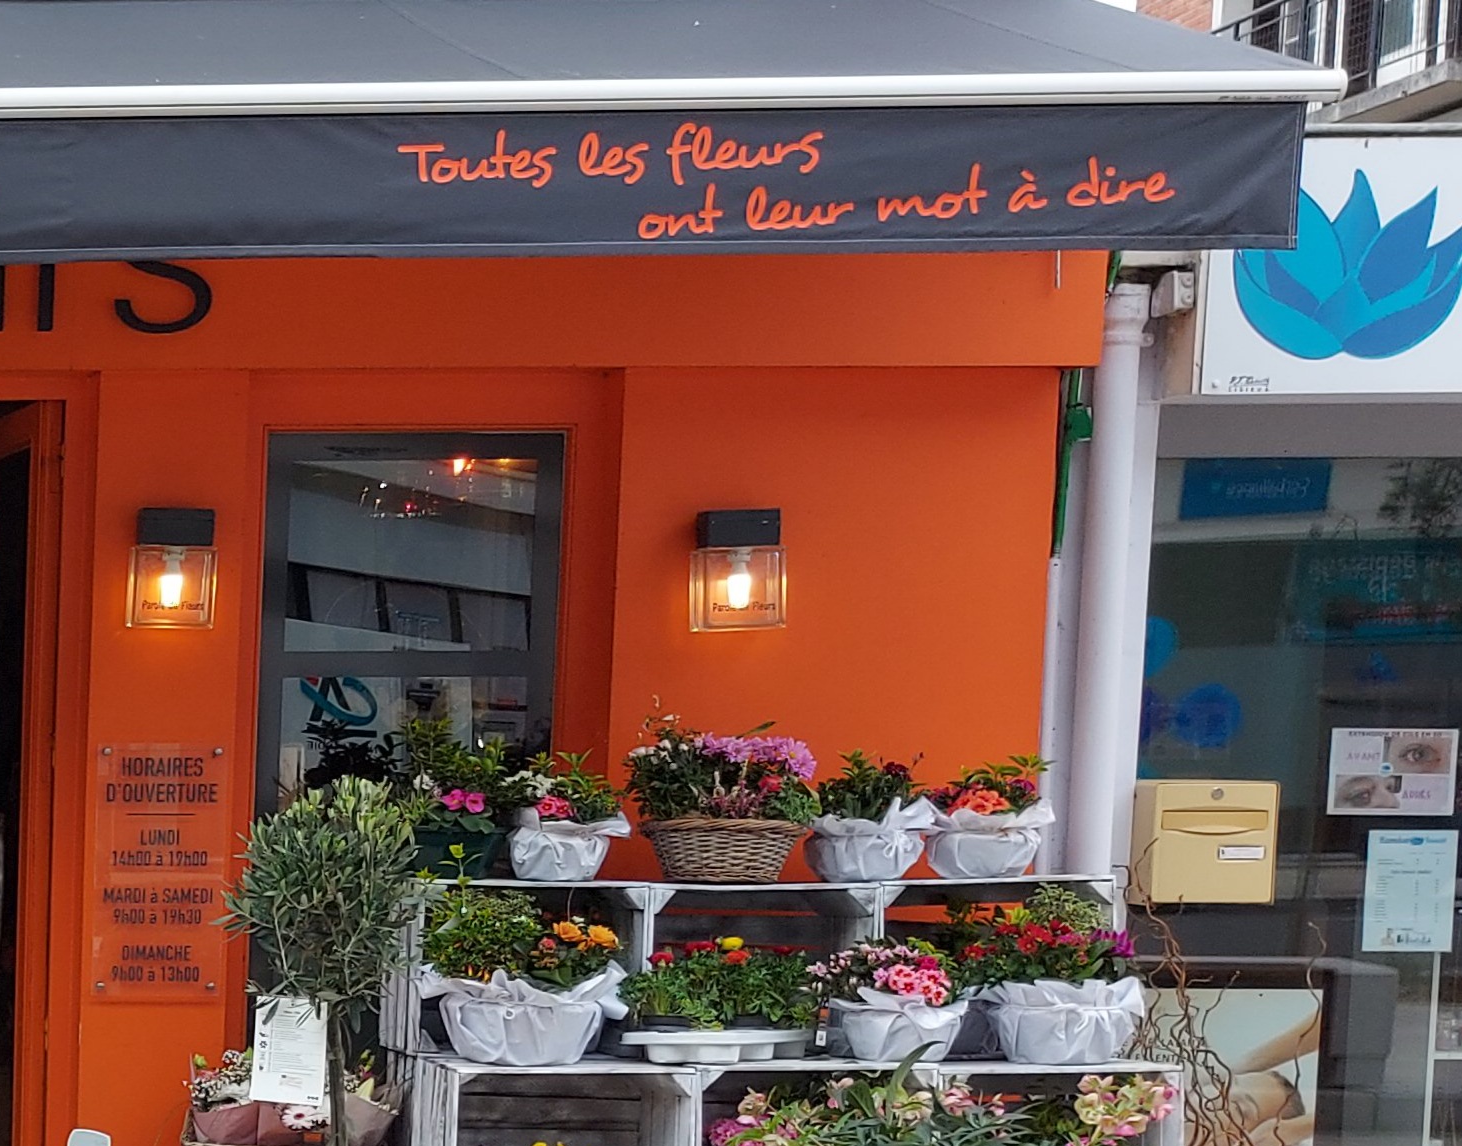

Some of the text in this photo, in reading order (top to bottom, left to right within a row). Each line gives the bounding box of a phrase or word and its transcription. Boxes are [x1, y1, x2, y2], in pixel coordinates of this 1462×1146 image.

[398, 123, 824, 190] Toutes les fleurs
[638, 157, 1176, 240] ont leur mot à dire
[121, 757, 204, 777] HORAIRES
[106, 783, 218, 803] D'OUVERTURE
[140, 829, 180, 846] LUNDI
[111, 850, 208, 867] 14h00 à 19h00
[102, 886, 214, 904] MARDI à SAMEDI
[113, 908, 202, 925] 9h00 à 19h30
[121, 945, 191, 961] DIMANCHE
[110, 966, 200, 982] 9h00 à 13h00
